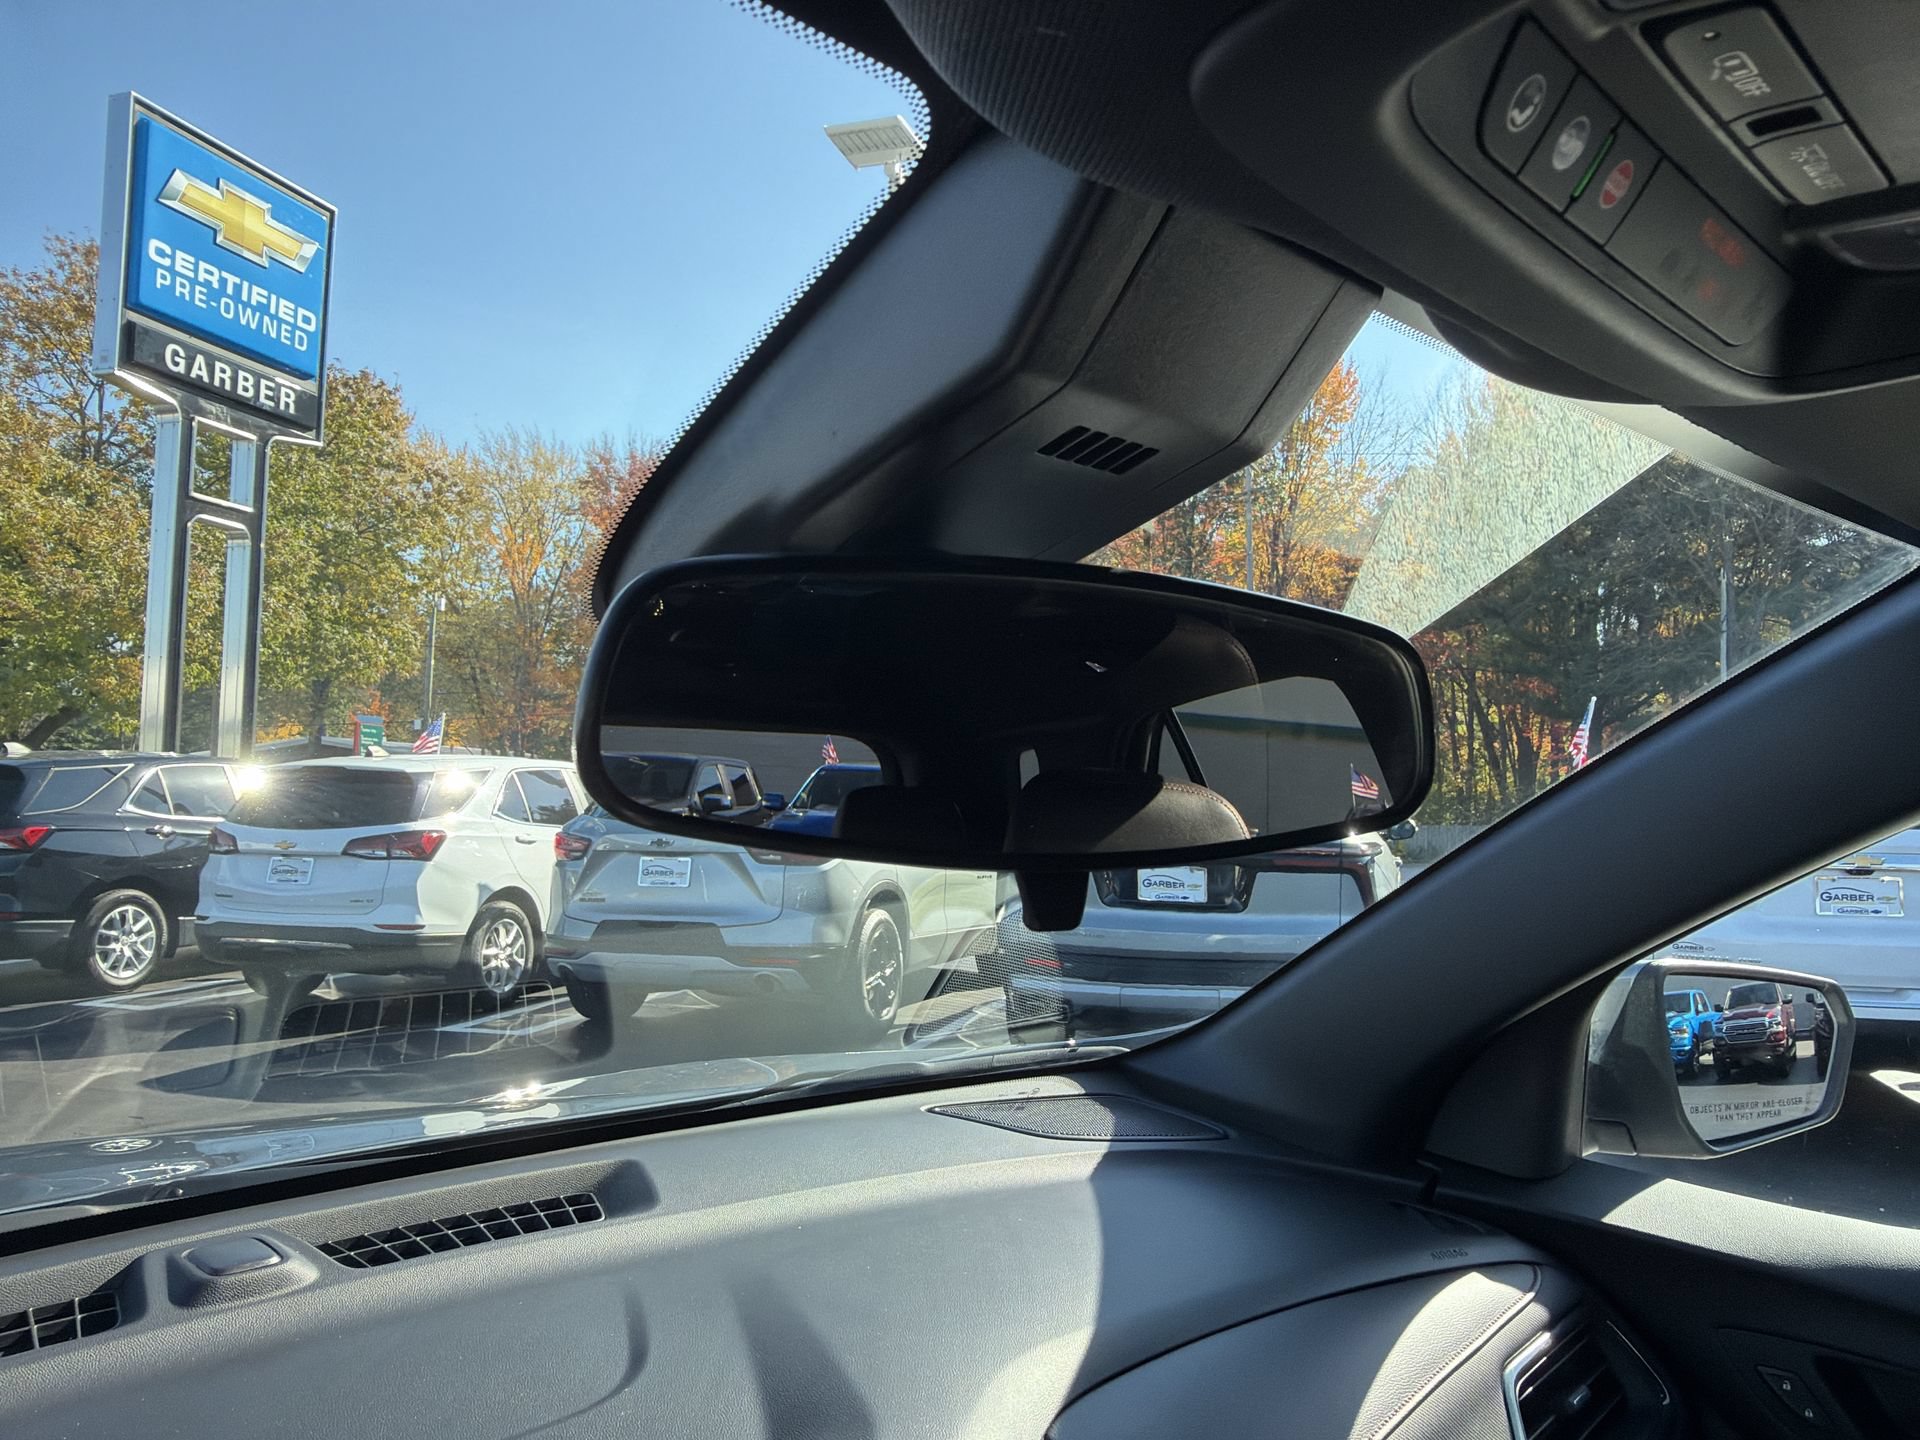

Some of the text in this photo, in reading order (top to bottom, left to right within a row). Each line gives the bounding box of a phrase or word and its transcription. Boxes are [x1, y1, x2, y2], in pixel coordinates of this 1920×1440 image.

[147, 238, 317, 333] CERTIFIED
[156, 268, 308, 352] PRE-OWNED
[164, 343, 296, 415] GARBER
[1142, 878, 1185, 889] GARBER
[1820, 891, 1875, 902] GARBER
[1690, 1103, 1722, 1115] OBJECTS
[1734, 1101, 1759, 1110] MIRROR
[1763, 1099, 1775, 1108] ARE
[1778, 1097, 1803, 1107] CLOSER
[1715, 1109, 1782, 1122] THAN THEY APPEAR
